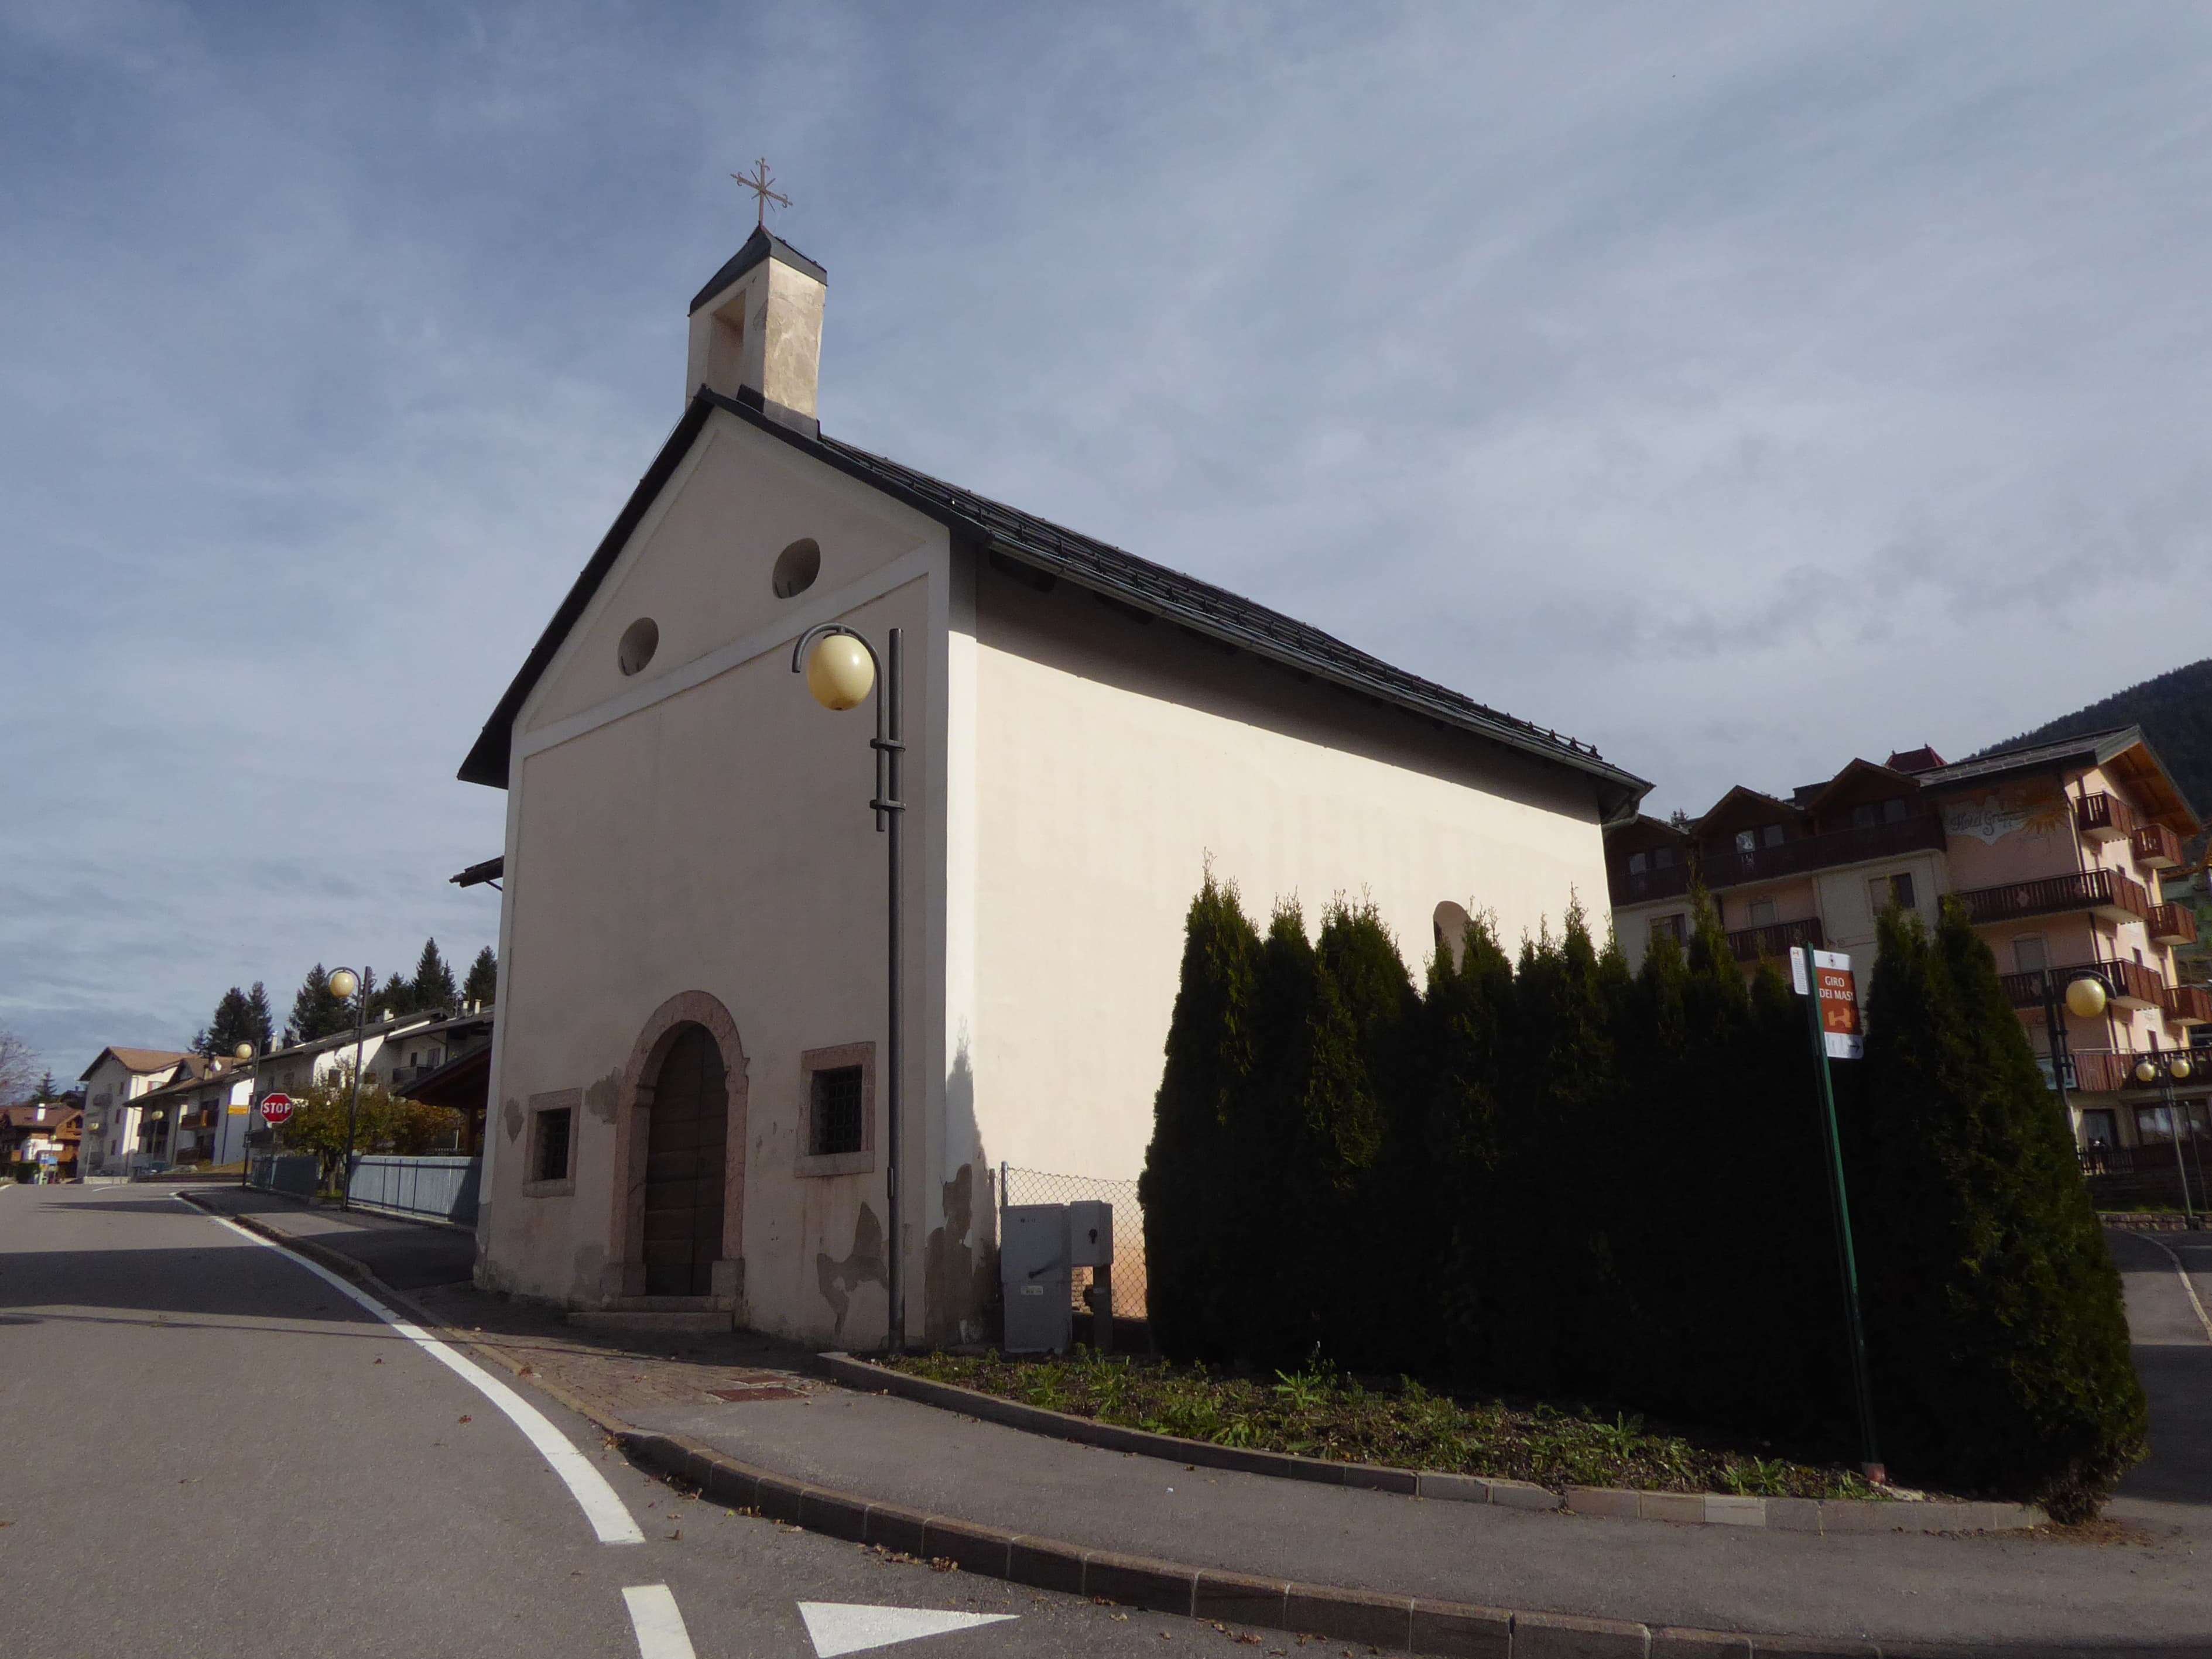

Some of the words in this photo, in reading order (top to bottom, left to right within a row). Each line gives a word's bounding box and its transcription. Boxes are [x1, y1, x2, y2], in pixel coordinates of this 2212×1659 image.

[1825, 976, 1845, 987] GIRO
[1819, 988, 1833, 999] DEI
[263, 1103, 291, 1113] STOP
